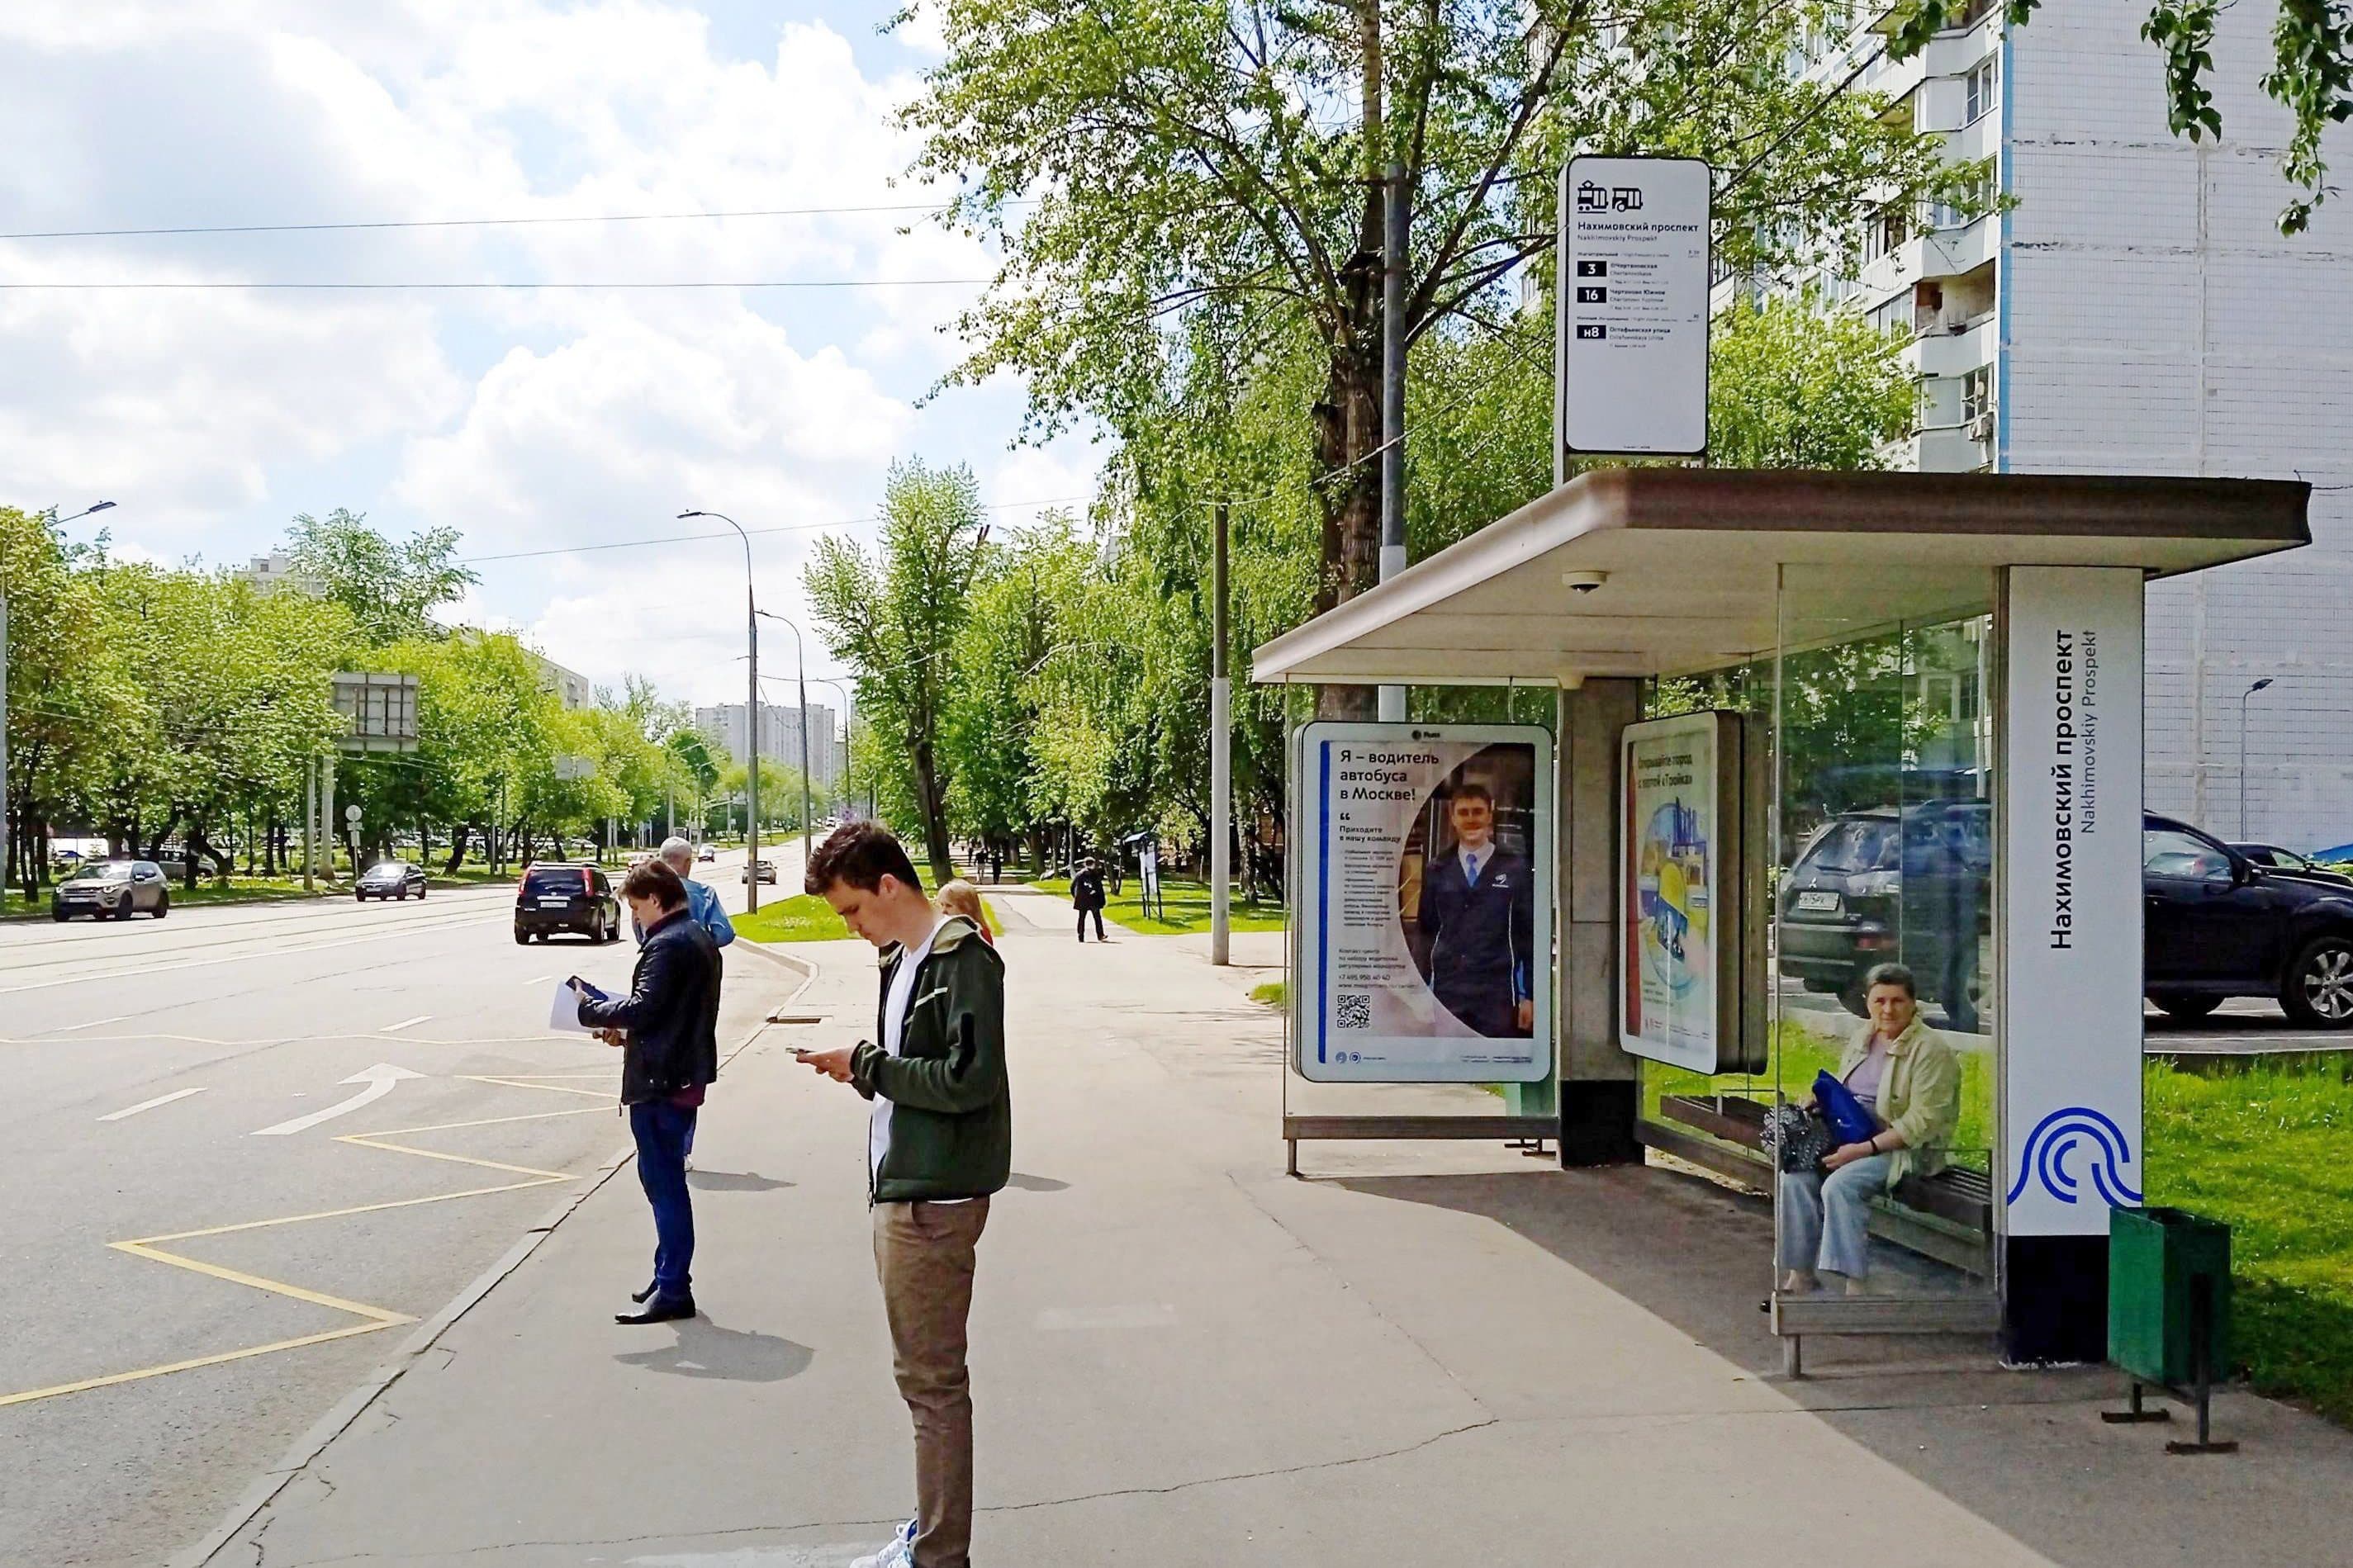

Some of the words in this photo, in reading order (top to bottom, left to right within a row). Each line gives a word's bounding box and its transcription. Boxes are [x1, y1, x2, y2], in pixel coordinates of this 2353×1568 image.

[1577, 221, 1649, 231] Нахимовский
[1651, 224, 1699, 232] проспект
[1587, 263, 1596, 275] 3
[1585, 289, 1599, 301] 16
[1583, 327, 1600, 338] н8
[2081, 630, 2099, 707] Prospekt
[2057, 629, 2077, 755] проспект
[1340, 750, 1351, 762] Я
[1369, 753, 1439, 765] водитель
[1340, 769, 1407, 784] автобуса
[2080, 713, 2099, 834] Nakhimovskiy
[1340, 789, 1348, 799] в
[1352, 787, 1416, 800] Москве!
[2051, 764, 2072, 950] Нахимовский
